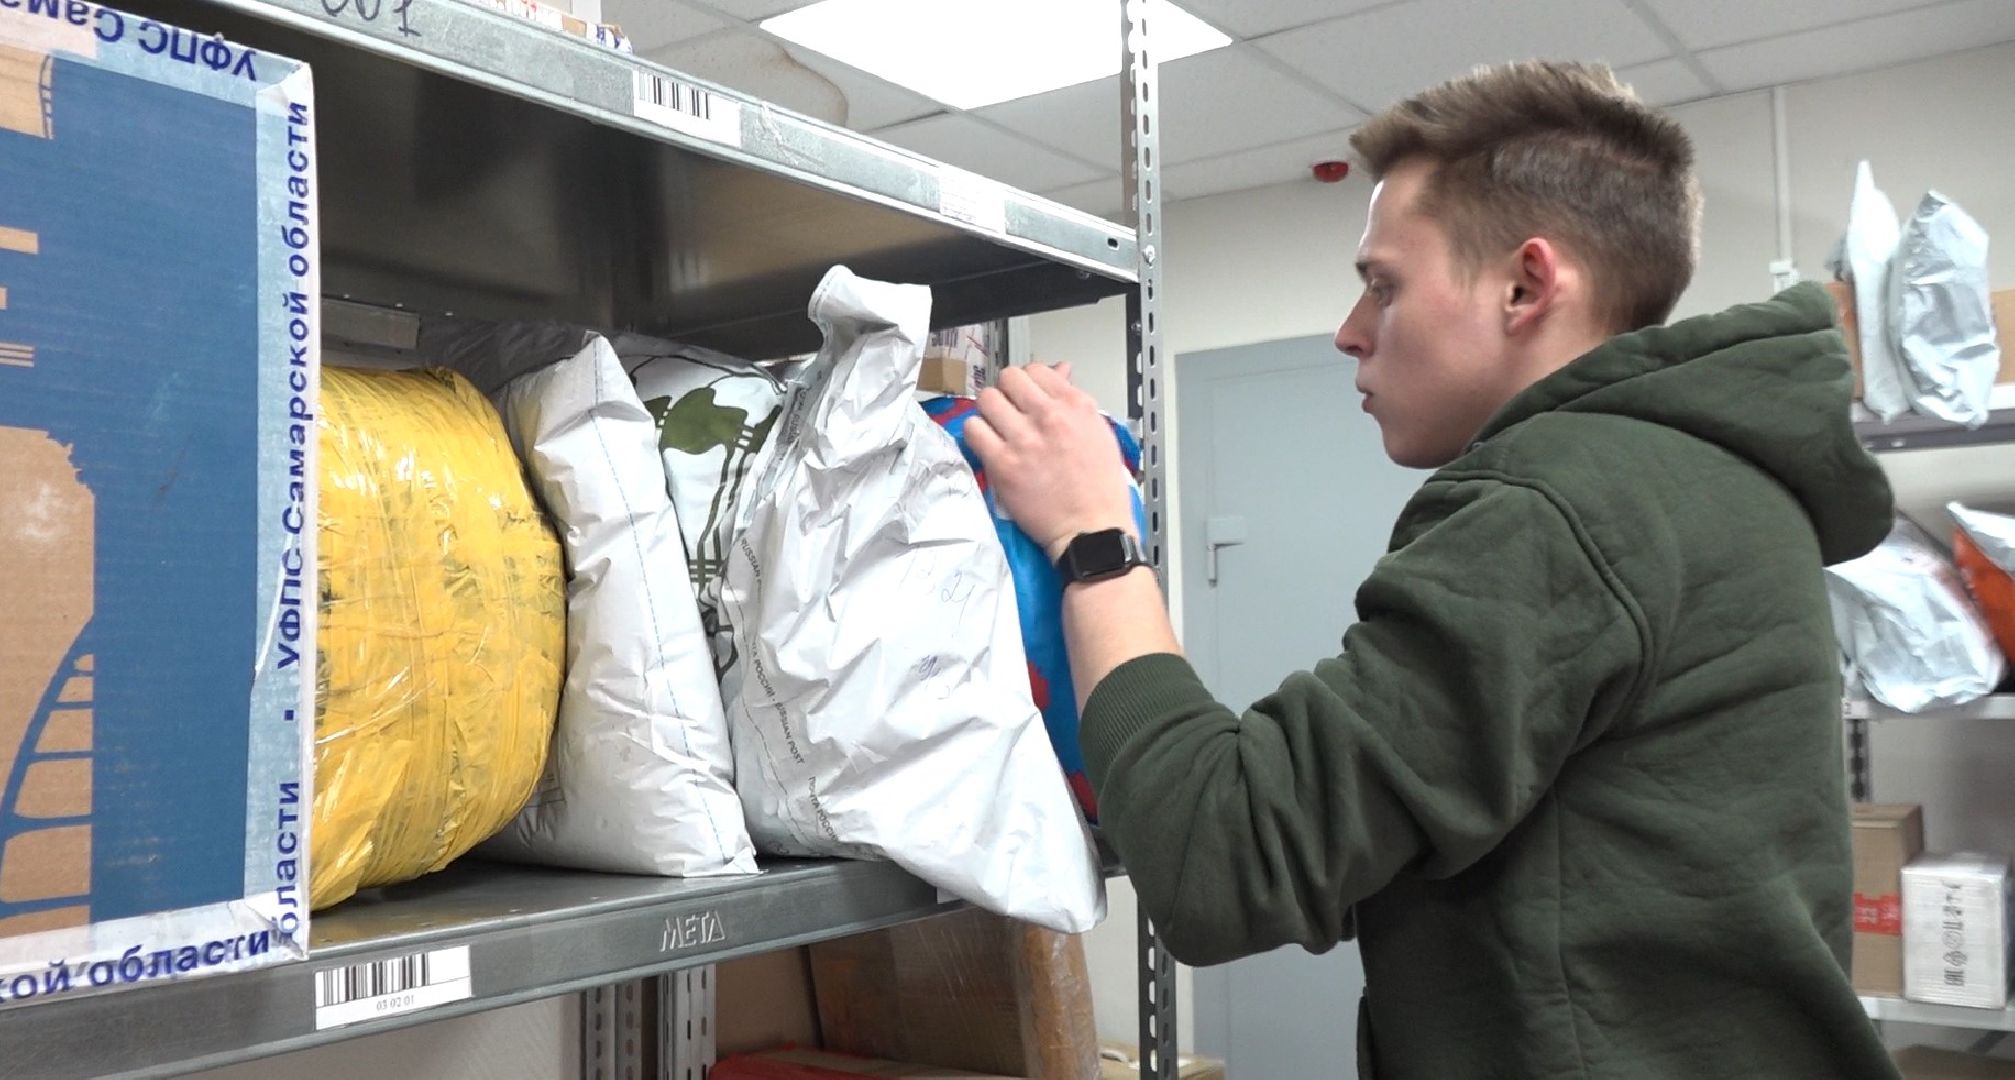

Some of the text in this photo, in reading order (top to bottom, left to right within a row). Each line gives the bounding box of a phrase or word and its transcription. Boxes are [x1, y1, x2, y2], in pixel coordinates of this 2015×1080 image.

[0, 0, 257, 81] УФПС Сам
[281, 102, 310, 277] области
[282, 290, 314, 534] Самарской
[277, 547, 303, 669] УФПС
[89, 929, 270, 987] области
[659, 911, 725, 952] META
